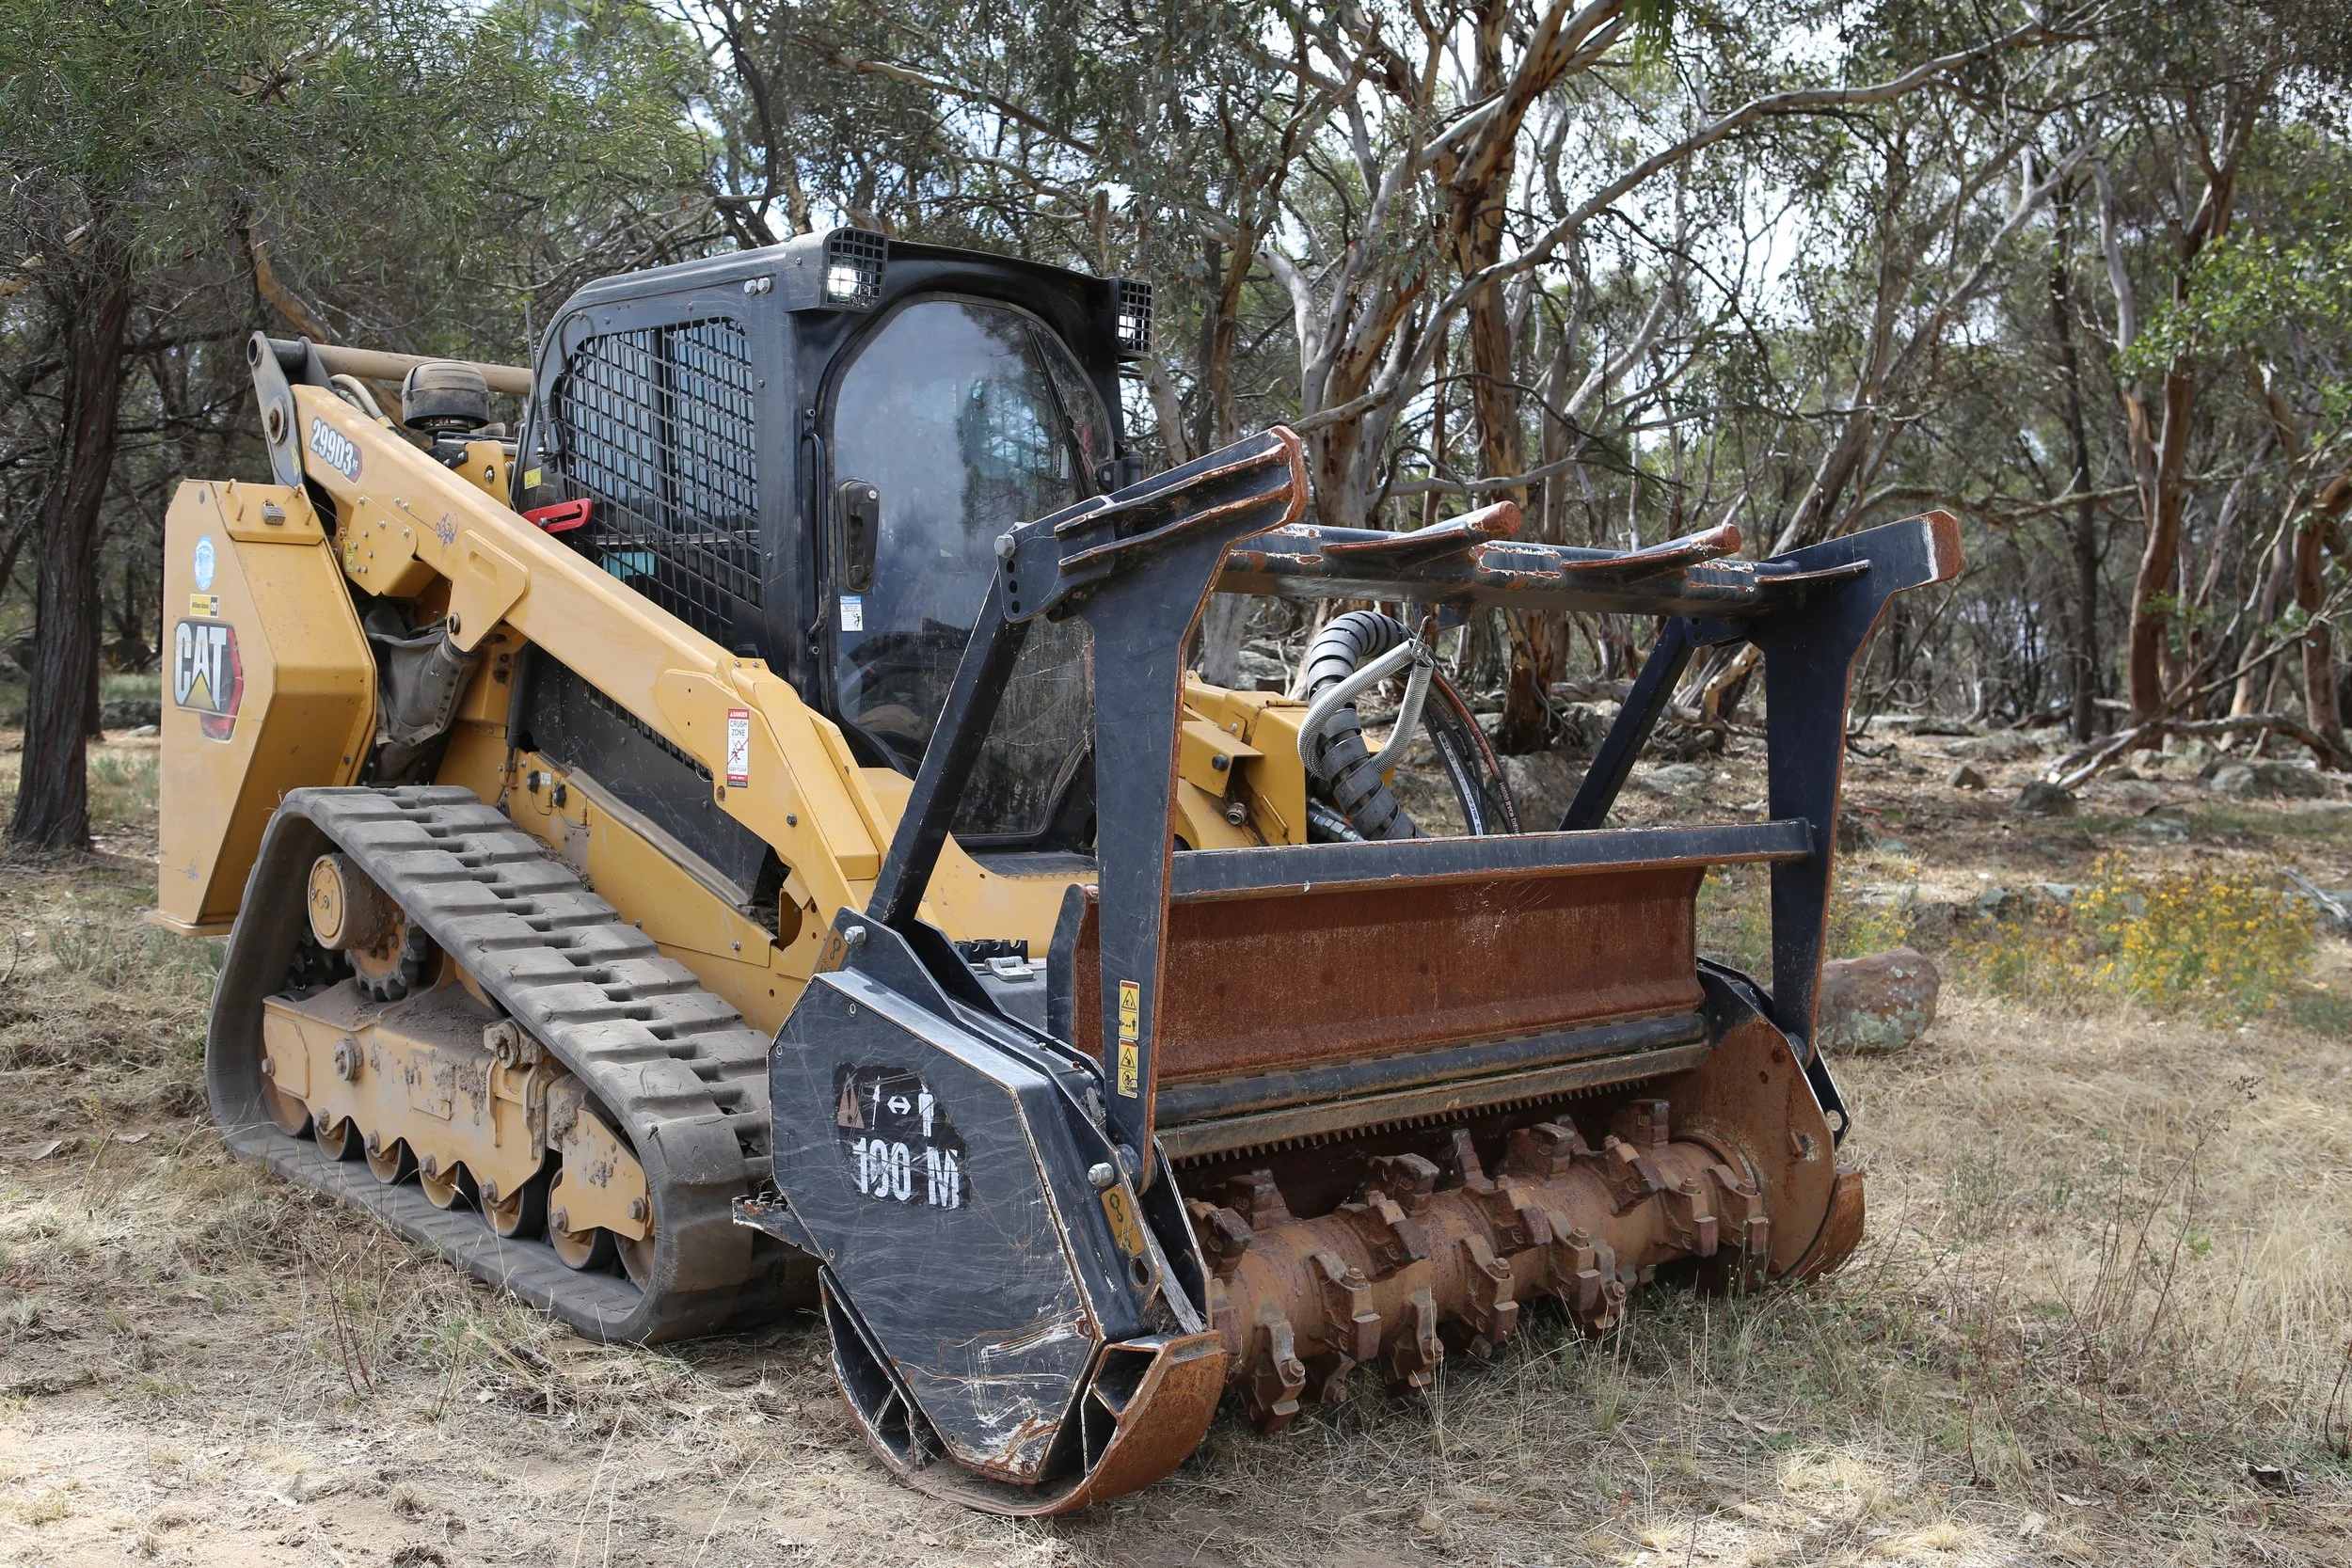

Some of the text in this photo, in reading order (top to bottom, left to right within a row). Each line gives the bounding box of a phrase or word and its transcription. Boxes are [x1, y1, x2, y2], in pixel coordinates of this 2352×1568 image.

[310, 419, 354, 475] 299D3
[175, 623, 227, 711] CAT
[730, 720, 748, 728] CRUSH
[731, 728, 745, 736] ZONE
[850, 1137, 960, 1209] 100 M
